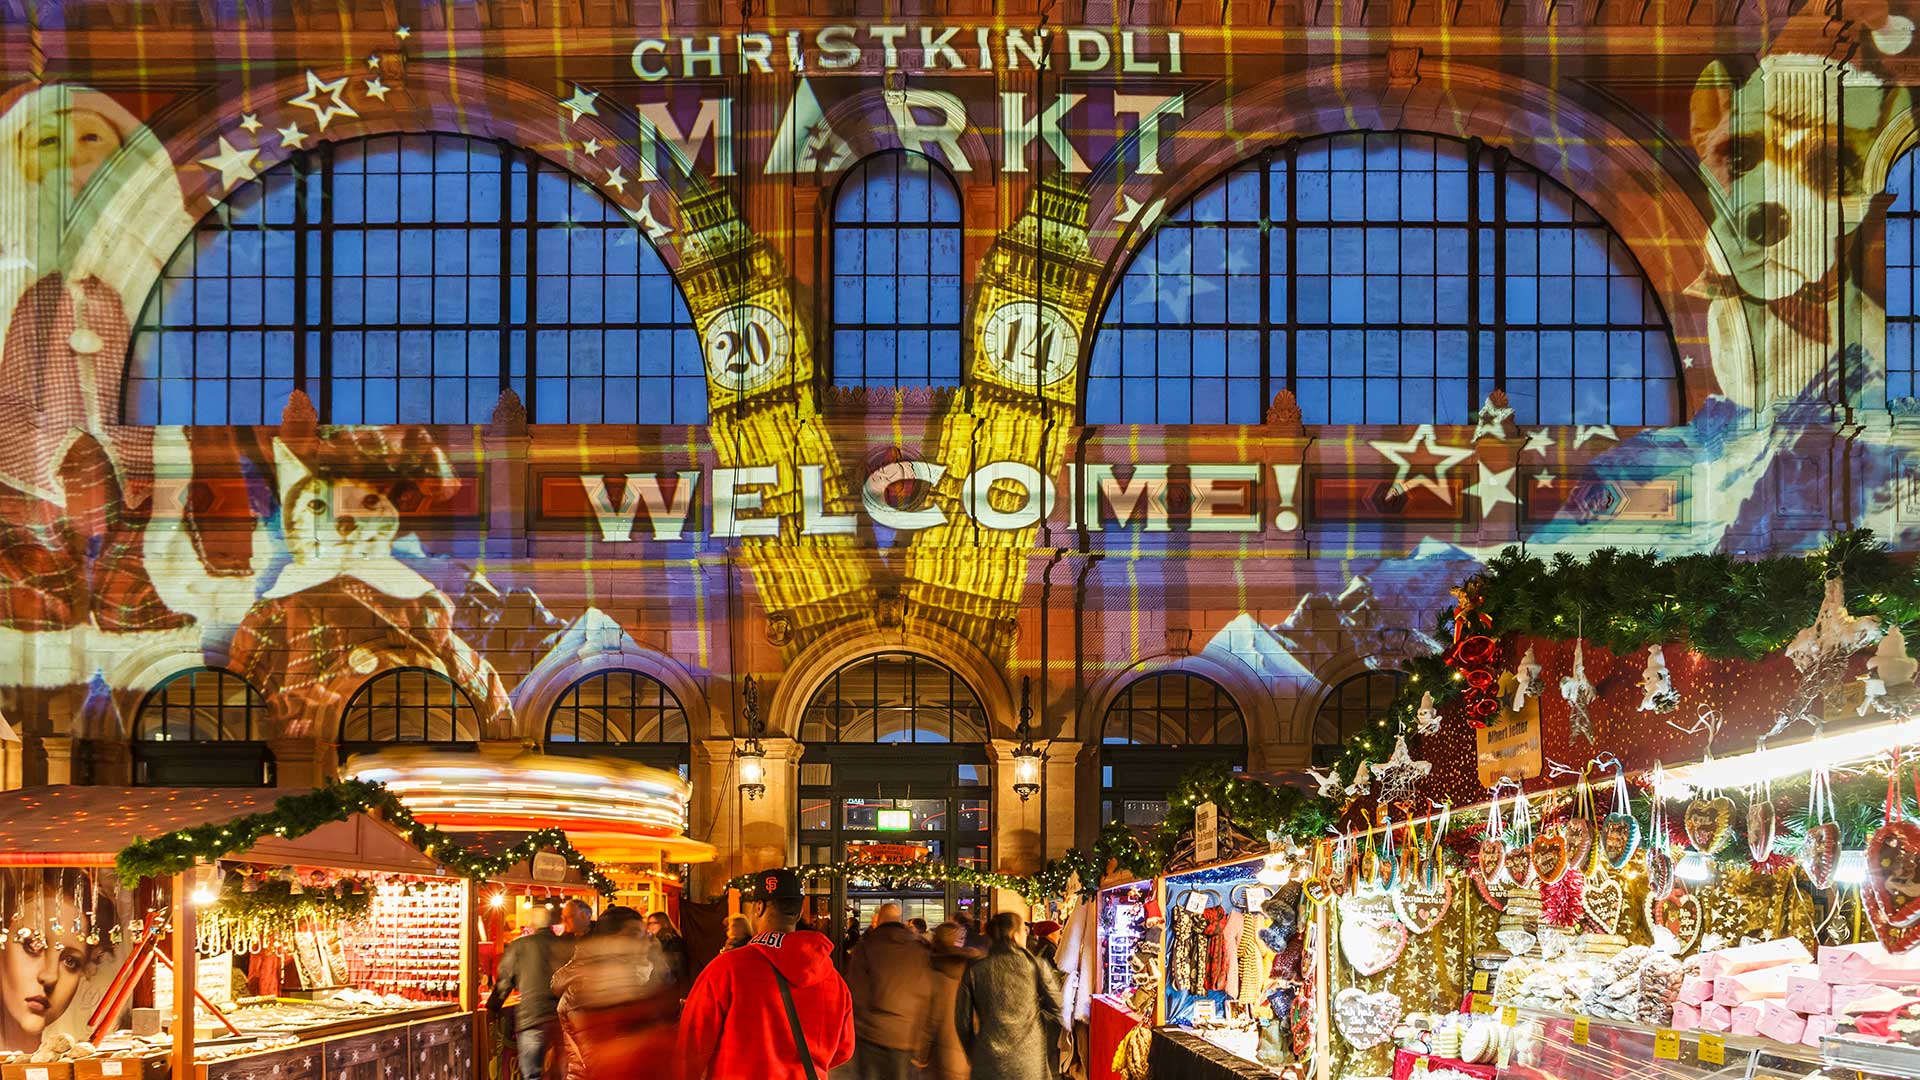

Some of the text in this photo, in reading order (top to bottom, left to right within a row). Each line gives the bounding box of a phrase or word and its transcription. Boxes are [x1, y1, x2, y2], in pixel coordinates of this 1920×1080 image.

[631, 25, 1183, 81] CHRISTKINDLI
[637, 78, 1185, 182] MARKT
[715, 320, 771, 375] 20
[1002, 316, 1057, 373] 14
[579, 460, 1302, 543] WELCOME!
